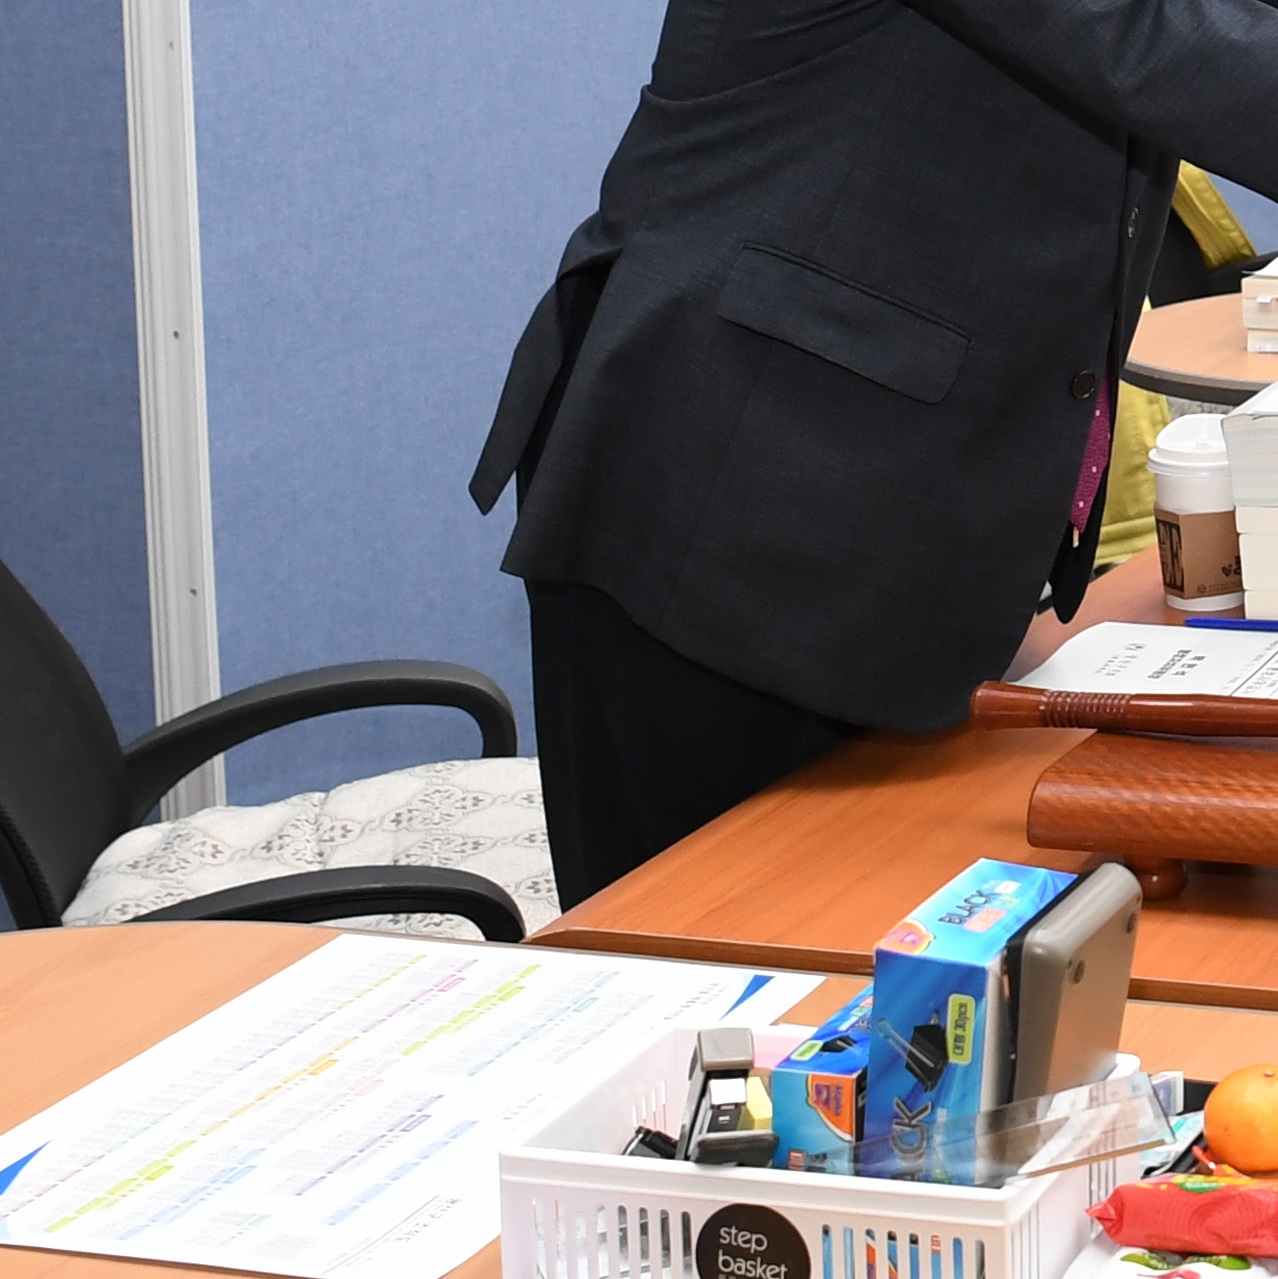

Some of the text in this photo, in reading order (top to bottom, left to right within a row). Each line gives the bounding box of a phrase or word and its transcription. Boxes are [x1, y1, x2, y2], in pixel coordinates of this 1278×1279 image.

[937, 889, 1001, 926] BLACK
[719, 1225, 768, 1254] step
[717, 1248, 789, 1279] basket
